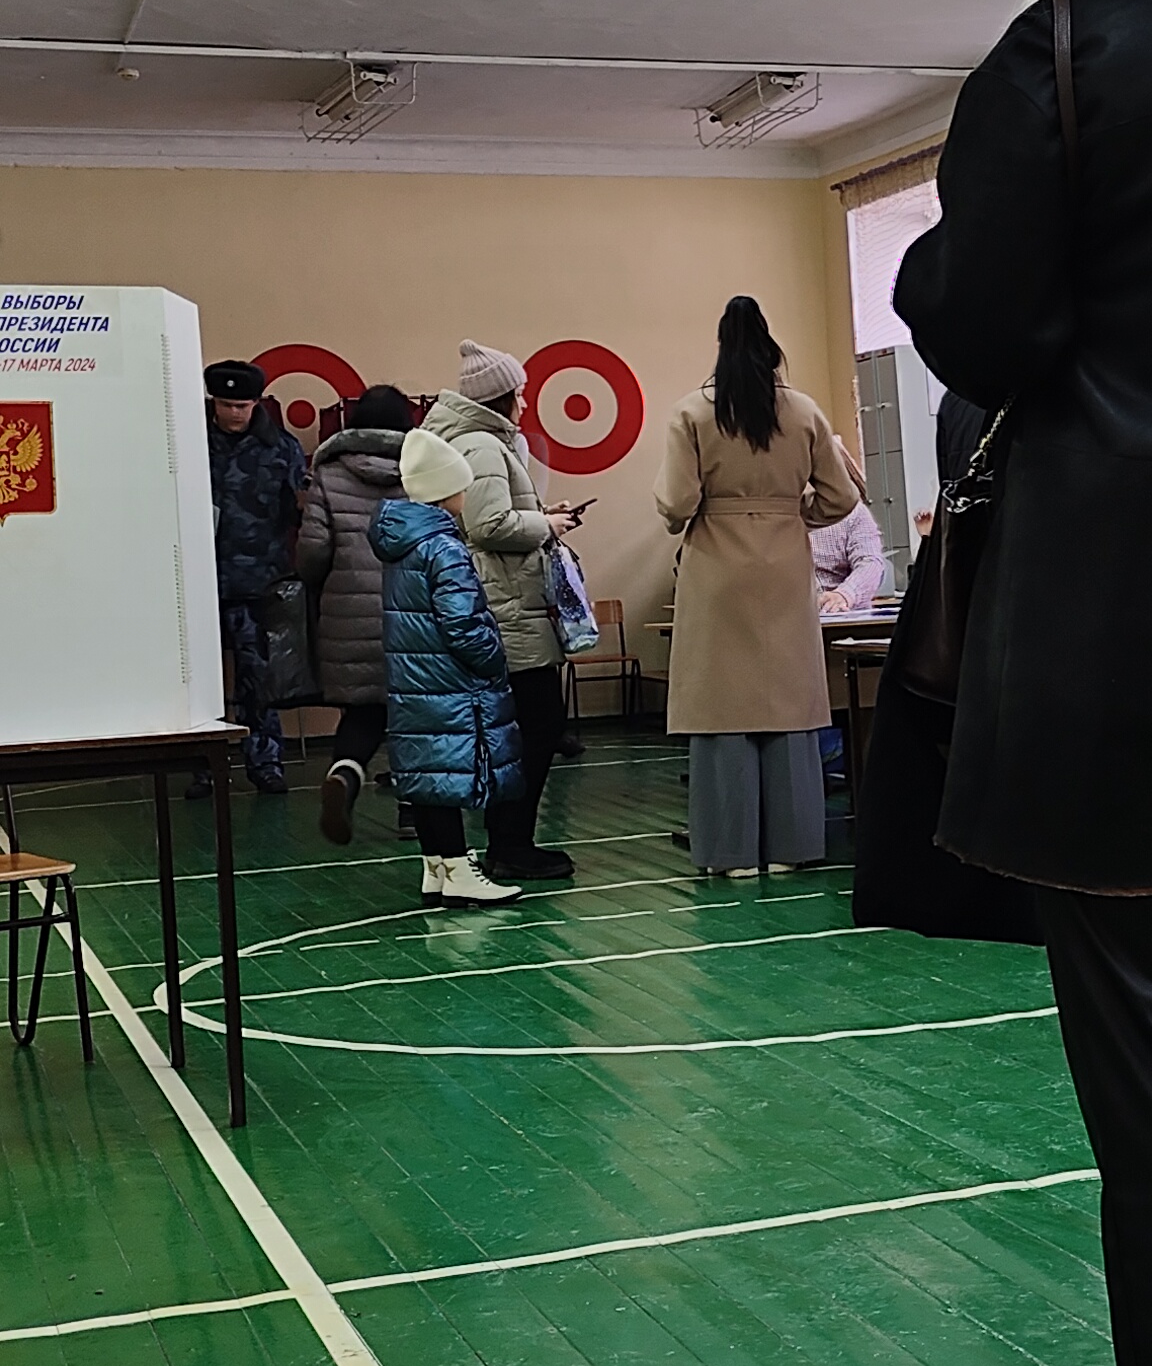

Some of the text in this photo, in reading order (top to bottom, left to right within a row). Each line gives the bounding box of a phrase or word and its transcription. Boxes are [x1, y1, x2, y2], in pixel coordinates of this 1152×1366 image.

[1, 295, 84, 311] ВЫБОРЫ
[17, 358, 62, 372] МАРТА
[64, 357, 97, 372] 2024
